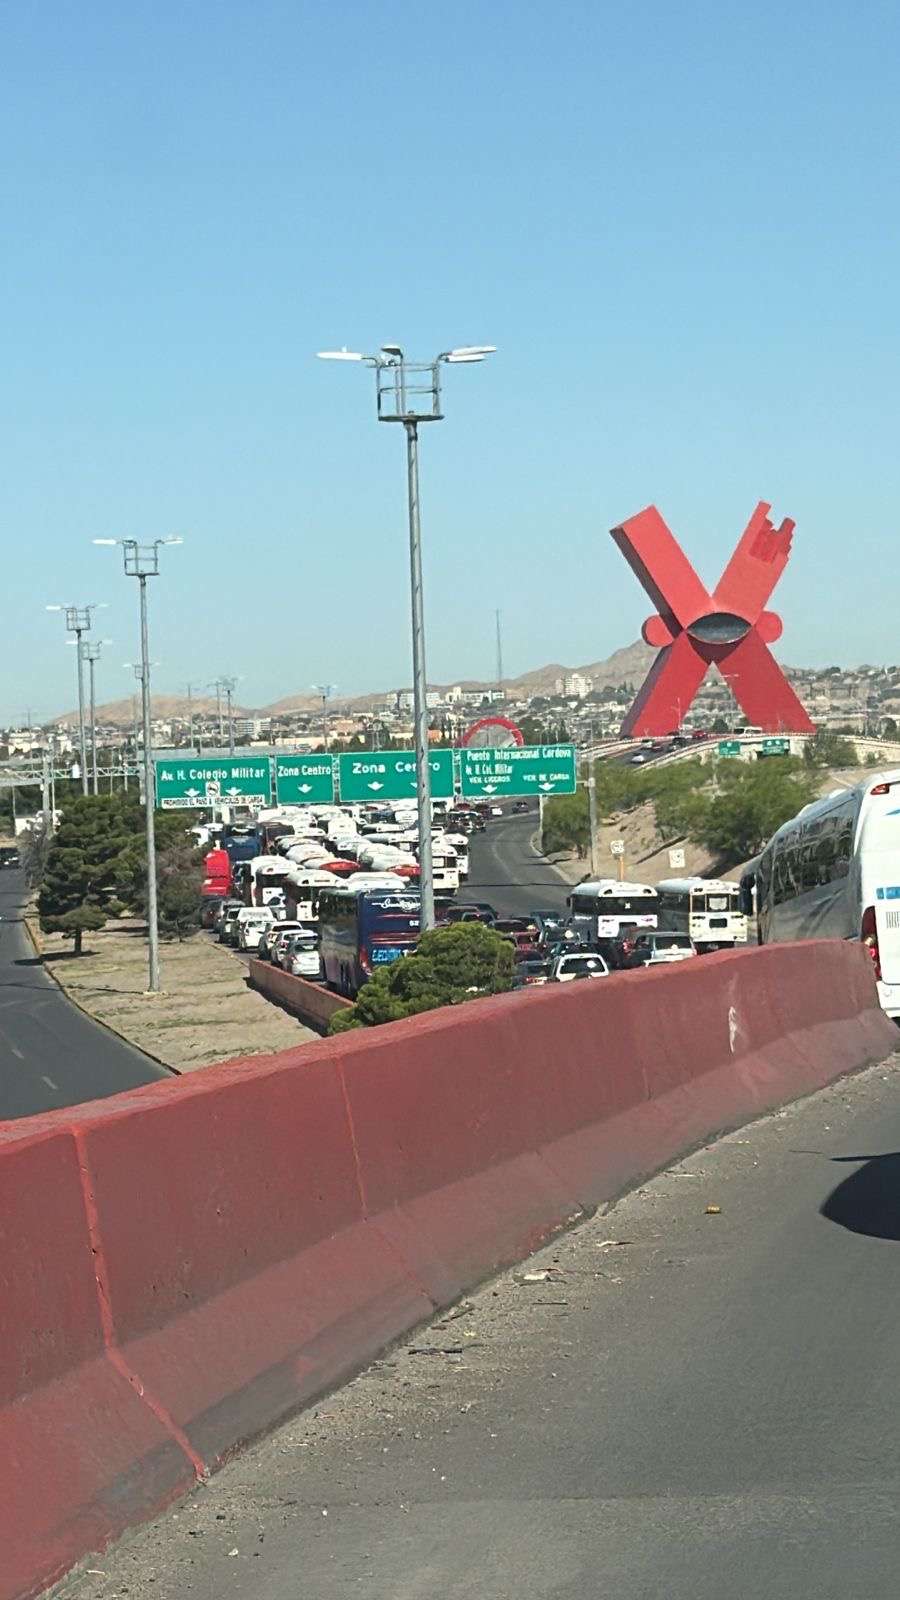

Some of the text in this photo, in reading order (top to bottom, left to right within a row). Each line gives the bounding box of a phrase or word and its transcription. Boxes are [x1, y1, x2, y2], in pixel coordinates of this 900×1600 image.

[189, 768, 228, 782] Colegio
[231, 767, 266, 779] Militar
[277, 764, 332, 778] Zona Centro
[352, 762, 386, 774] Zona
